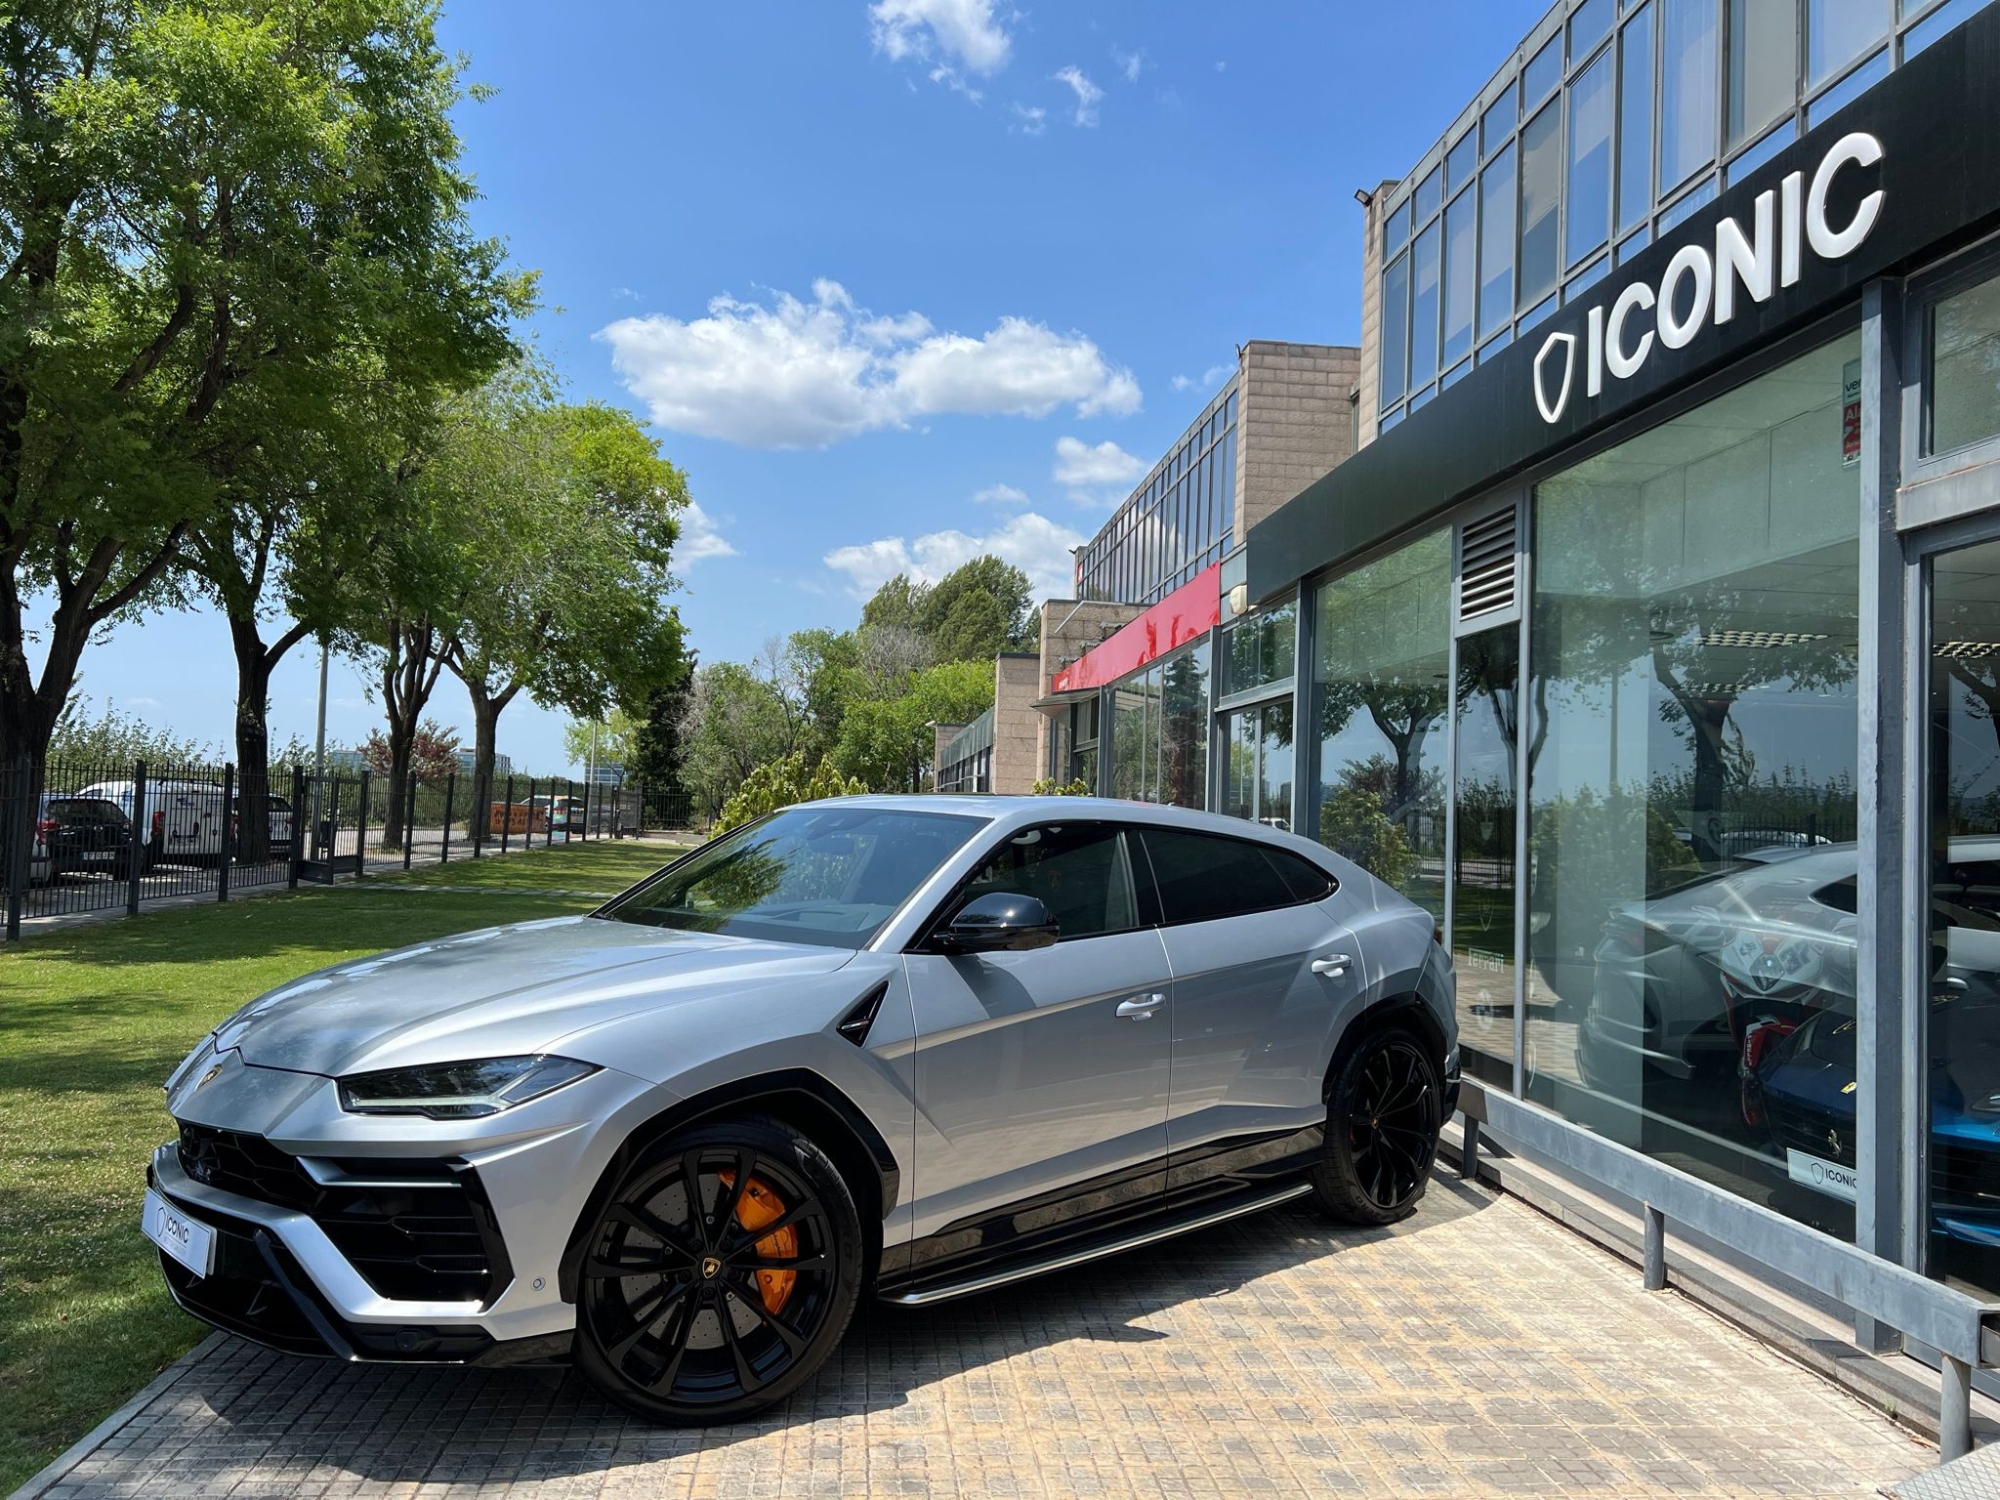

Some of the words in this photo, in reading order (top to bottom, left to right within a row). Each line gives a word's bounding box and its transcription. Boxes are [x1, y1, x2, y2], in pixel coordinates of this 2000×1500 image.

[1586, 131, 1886, 398] ICONIC
[1467, 947, 1505, 974] Ferrari
[165, 1214, 190, 1244] ICONIC
